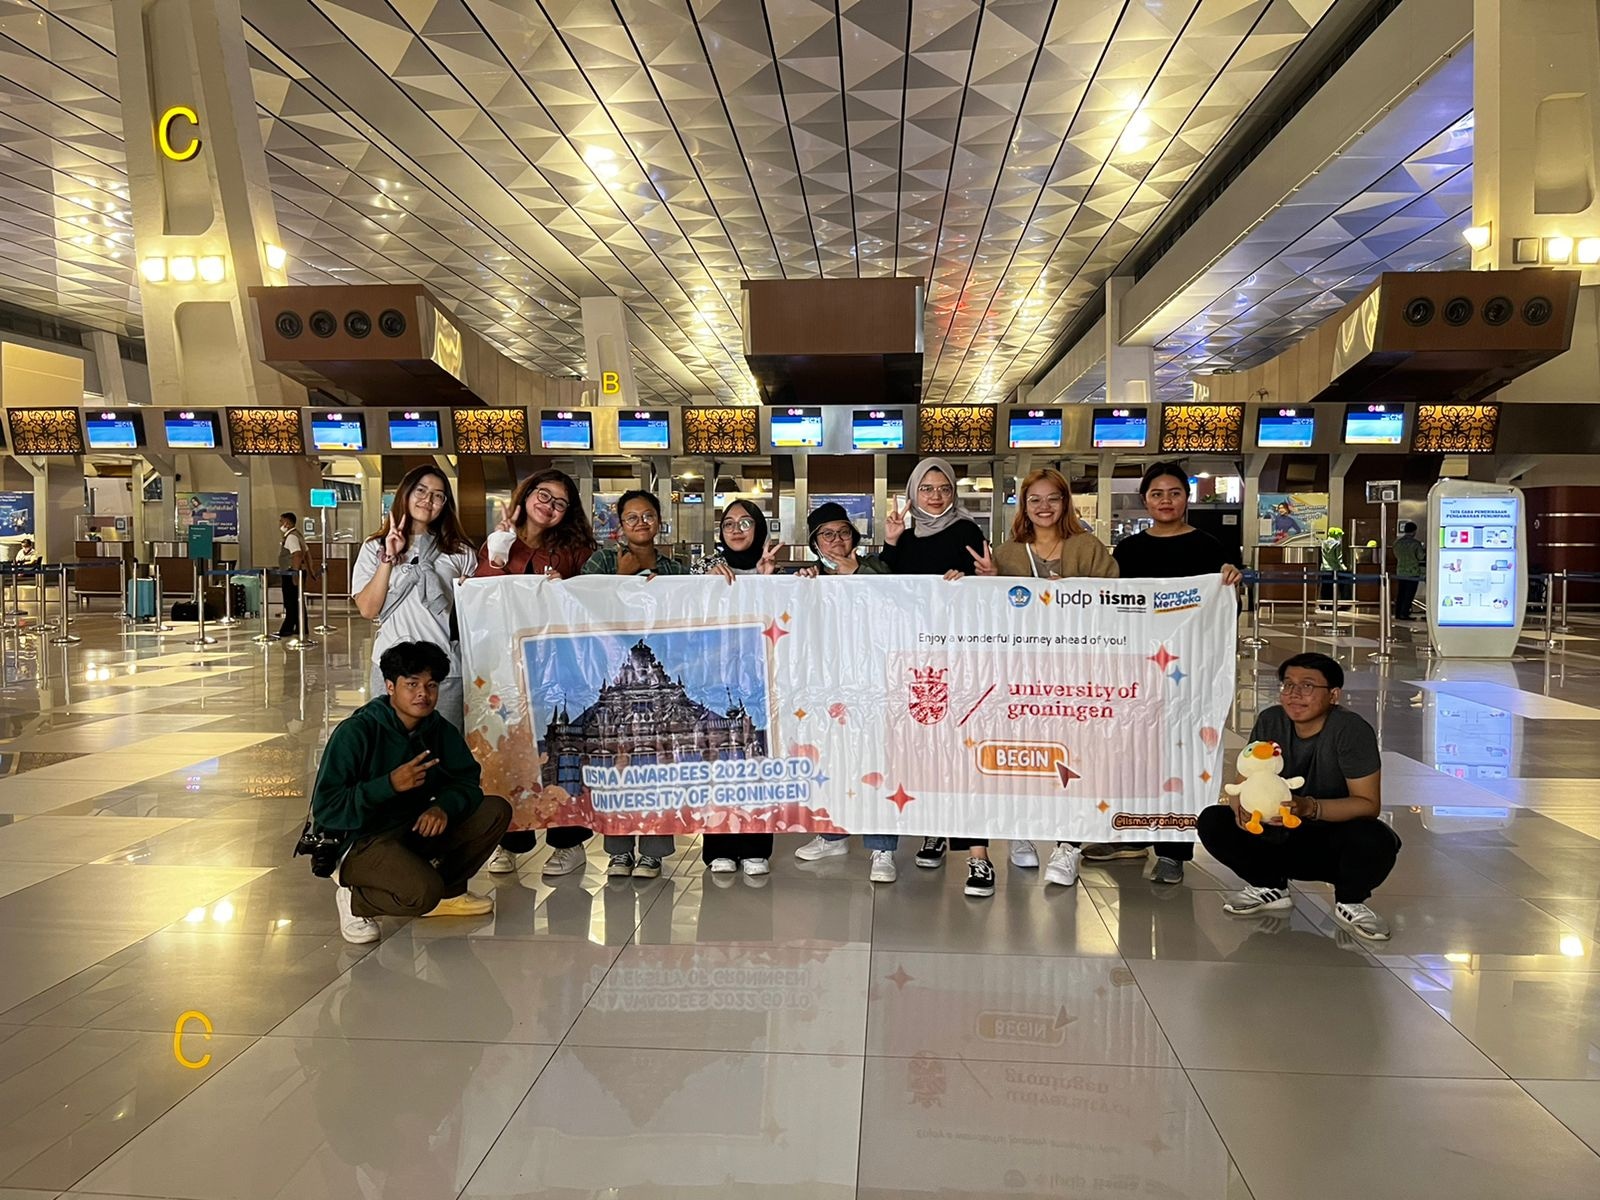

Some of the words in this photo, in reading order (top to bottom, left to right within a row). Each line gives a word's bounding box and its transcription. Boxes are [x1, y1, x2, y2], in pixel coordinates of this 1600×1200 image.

[158, 105, 202, 162] C
[602, 371, 621, 395] B
[1055, 589, 1092, 608] lpdp
[1099, 590, 1146, 606] iisma
[1153, 588, 1199, 601] Kampus
[1153, 595, 1201, 609] Merdeka
[919, 633, 947, 646] Enjoy
[949, 635, 955, 643] a
[958, 634, 1010, 644] wonderful
[1012, 634, 1051, 646] journey
[1054, 634, 1087, 645] ahead
[1089, 634, 1101, 645] of
[1103, 635, 1127, 647] you!
[1008, 680, 1116, 702] university
[1118, 682, 1139, 699] of
[1007, 700, 1115, 721] groningen
[996, 749, 1049, 768] BEGIN
[585, 766, 619, 786] IISMA
[624, 763, 710, 785] AWARDEES
[714, 762, 757, 780] 2022
[762, 761, 784, 777] GO
[788, 759, 811, 776] TO
[593, 789, 684, 810] UNIVERSITY
[689, 788, 710, 806] OF
[714, 782, 808, 803] GRONINGEN
